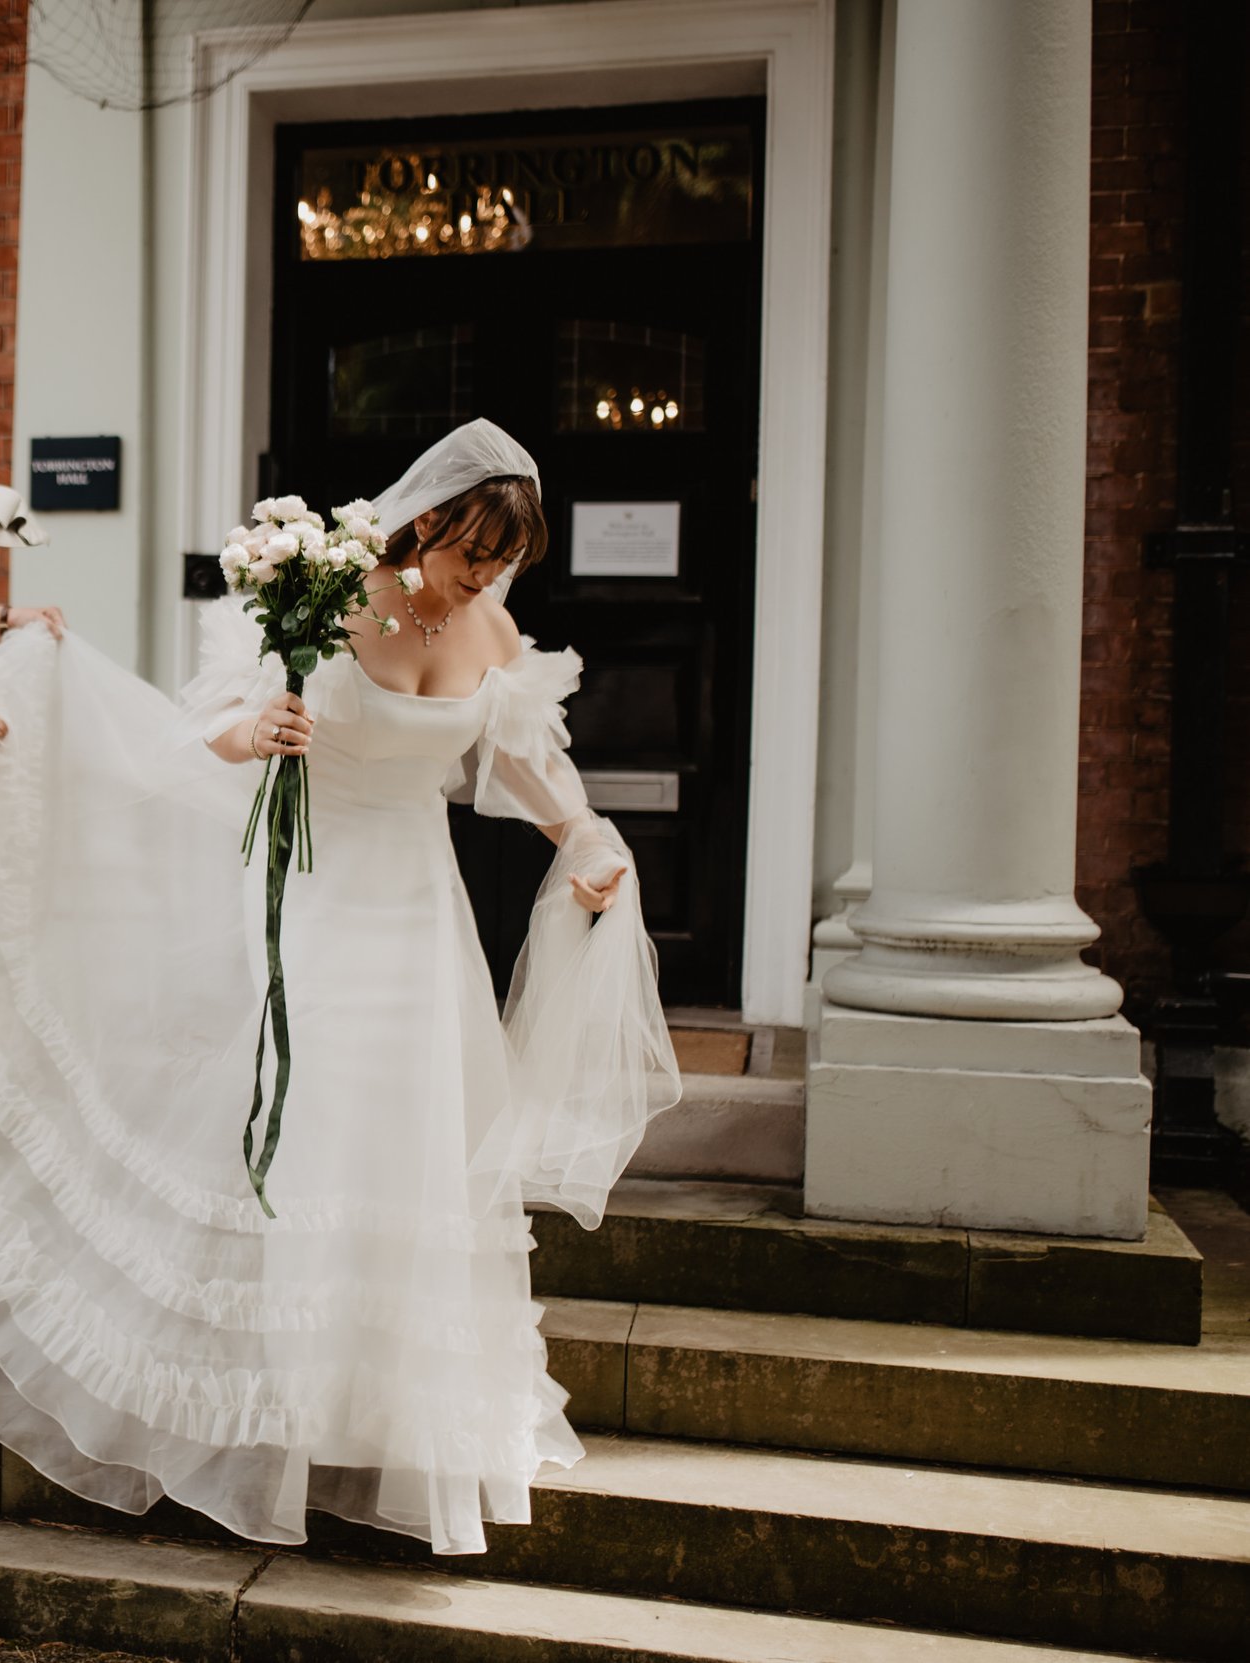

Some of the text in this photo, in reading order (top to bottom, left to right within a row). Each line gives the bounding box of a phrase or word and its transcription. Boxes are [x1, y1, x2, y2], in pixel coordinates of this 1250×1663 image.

[349, 143, 701, 194] TORRINGTON
[32, 459, 115, 473] TORRINGTON
[56, 473, 88, 485] HALL
